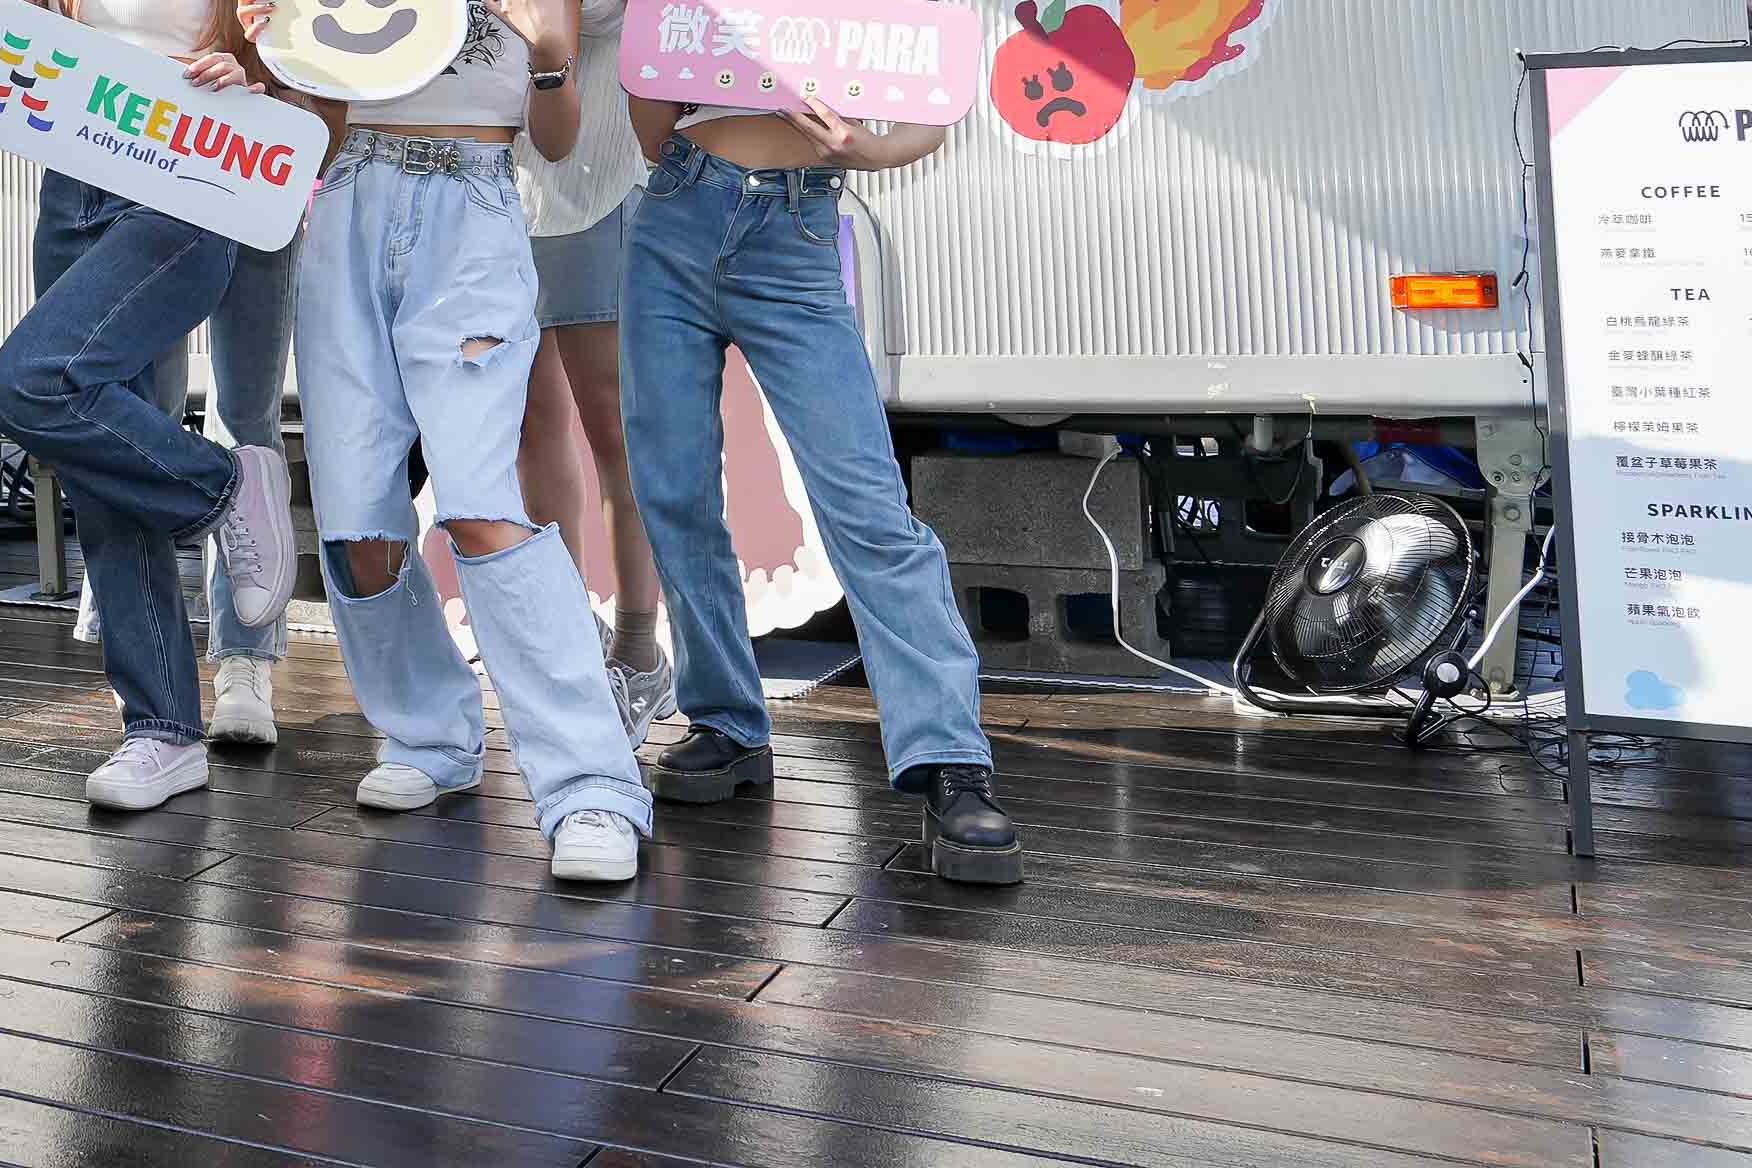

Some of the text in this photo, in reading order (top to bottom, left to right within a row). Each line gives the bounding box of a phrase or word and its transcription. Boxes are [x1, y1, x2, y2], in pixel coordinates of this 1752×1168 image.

[658, 3, 940, 76] 微笑 PARA
[86, 75, 295, 187] KEELUNG
[76, 124, 179, 174] A city full of
[1641, 185, 1721, 198] COFFEE
[1670, 288, 1711, 301] TEA
[1615, 455, 1718, 471] 覆盆子草莓果茶
[1622, 531, 1696, 546] 接骨木泡泡
[1624, 567, 1683, 581] 芒果泡泡
[1627, 603, 1701, 619] 蘋果氣泡飲
